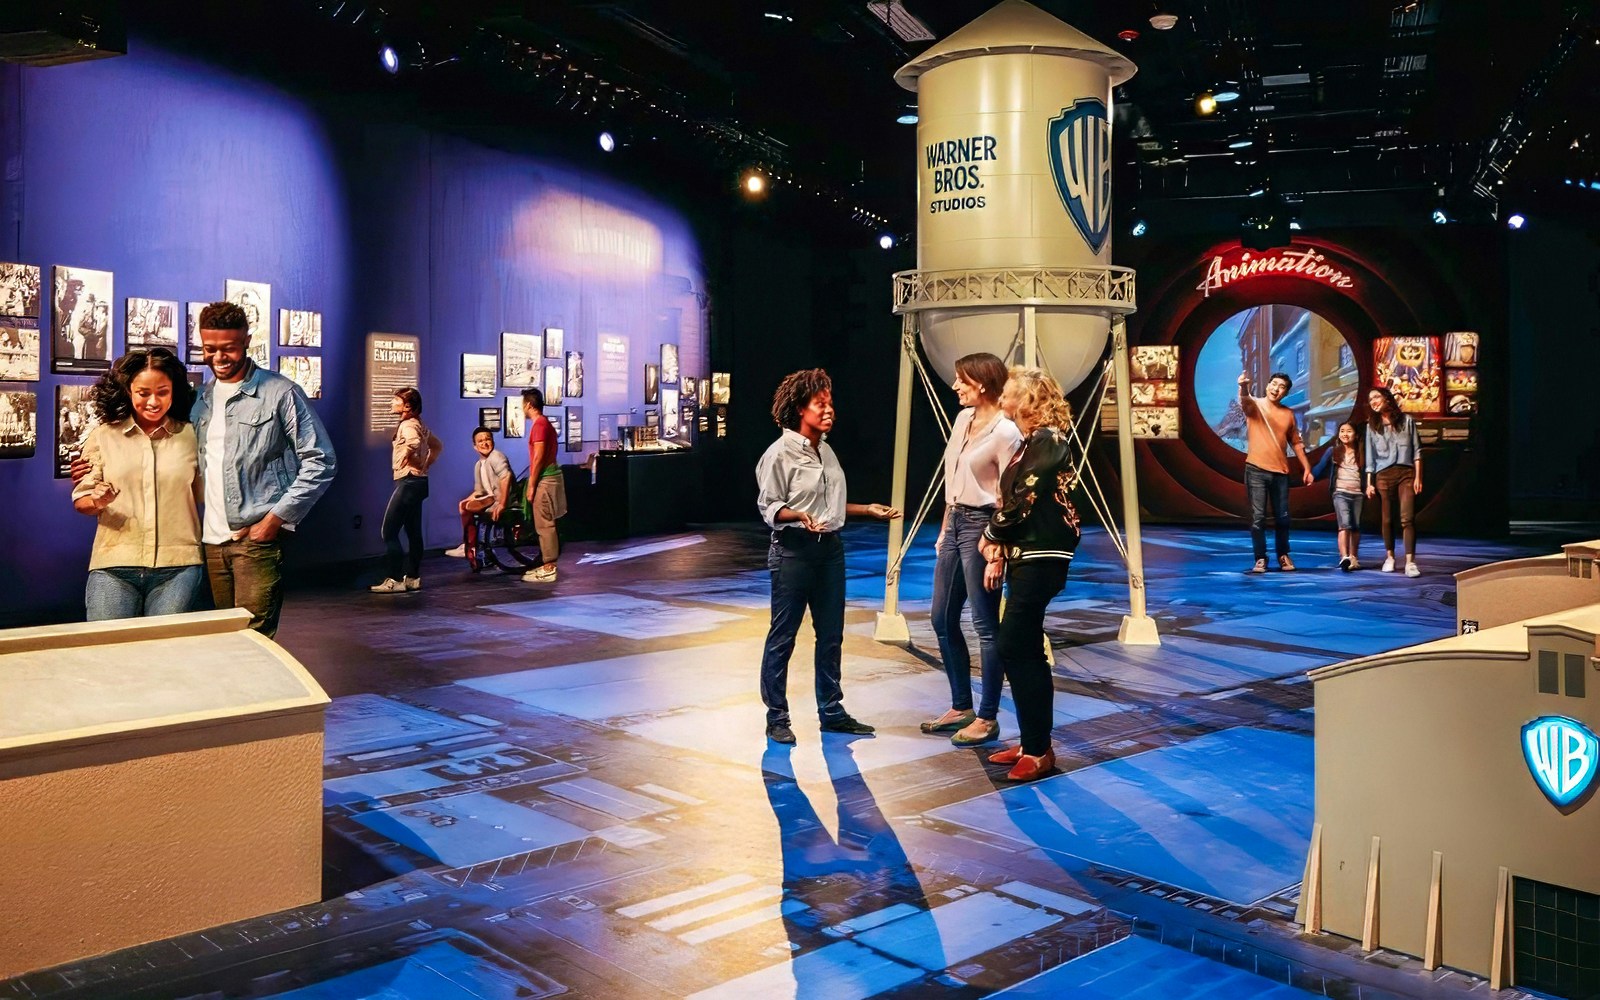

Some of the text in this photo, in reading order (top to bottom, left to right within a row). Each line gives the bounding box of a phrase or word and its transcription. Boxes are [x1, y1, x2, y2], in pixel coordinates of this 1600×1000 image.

[926, 135, 997, 169] WARNER
[934, 165, 984, 194] BROS.
[930, 196, 986, 214] STUDIOS
[1196, 248, 1353, 297] Animation
[1526, 725, 1590, 793] WB
